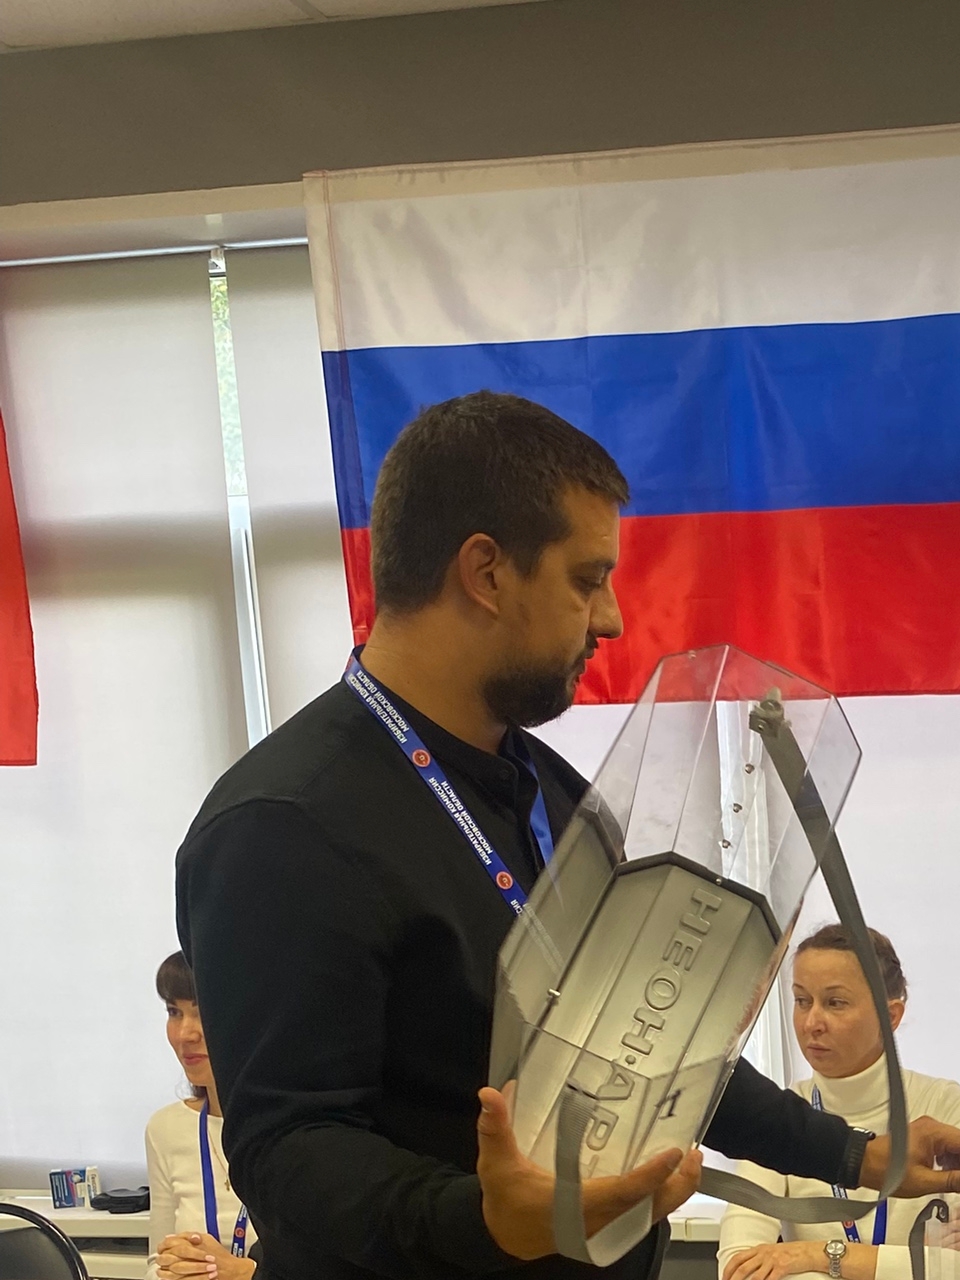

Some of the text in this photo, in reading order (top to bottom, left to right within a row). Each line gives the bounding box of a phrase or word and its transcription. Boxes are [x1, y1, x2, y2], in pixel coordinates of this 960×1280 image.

[366, 696, 408, 744] ИЗБИРАТЕЛЬНАЯ
[372, 691, 410, 732] МОСКОВСКОЙ
[428, 776, 493, 866] ИЗБИРАТЕЛЬНАЯ КОМИССИЯ
[440, 780, 494, 855] МОСКОВСКОЙ ОБЛАСТИ
